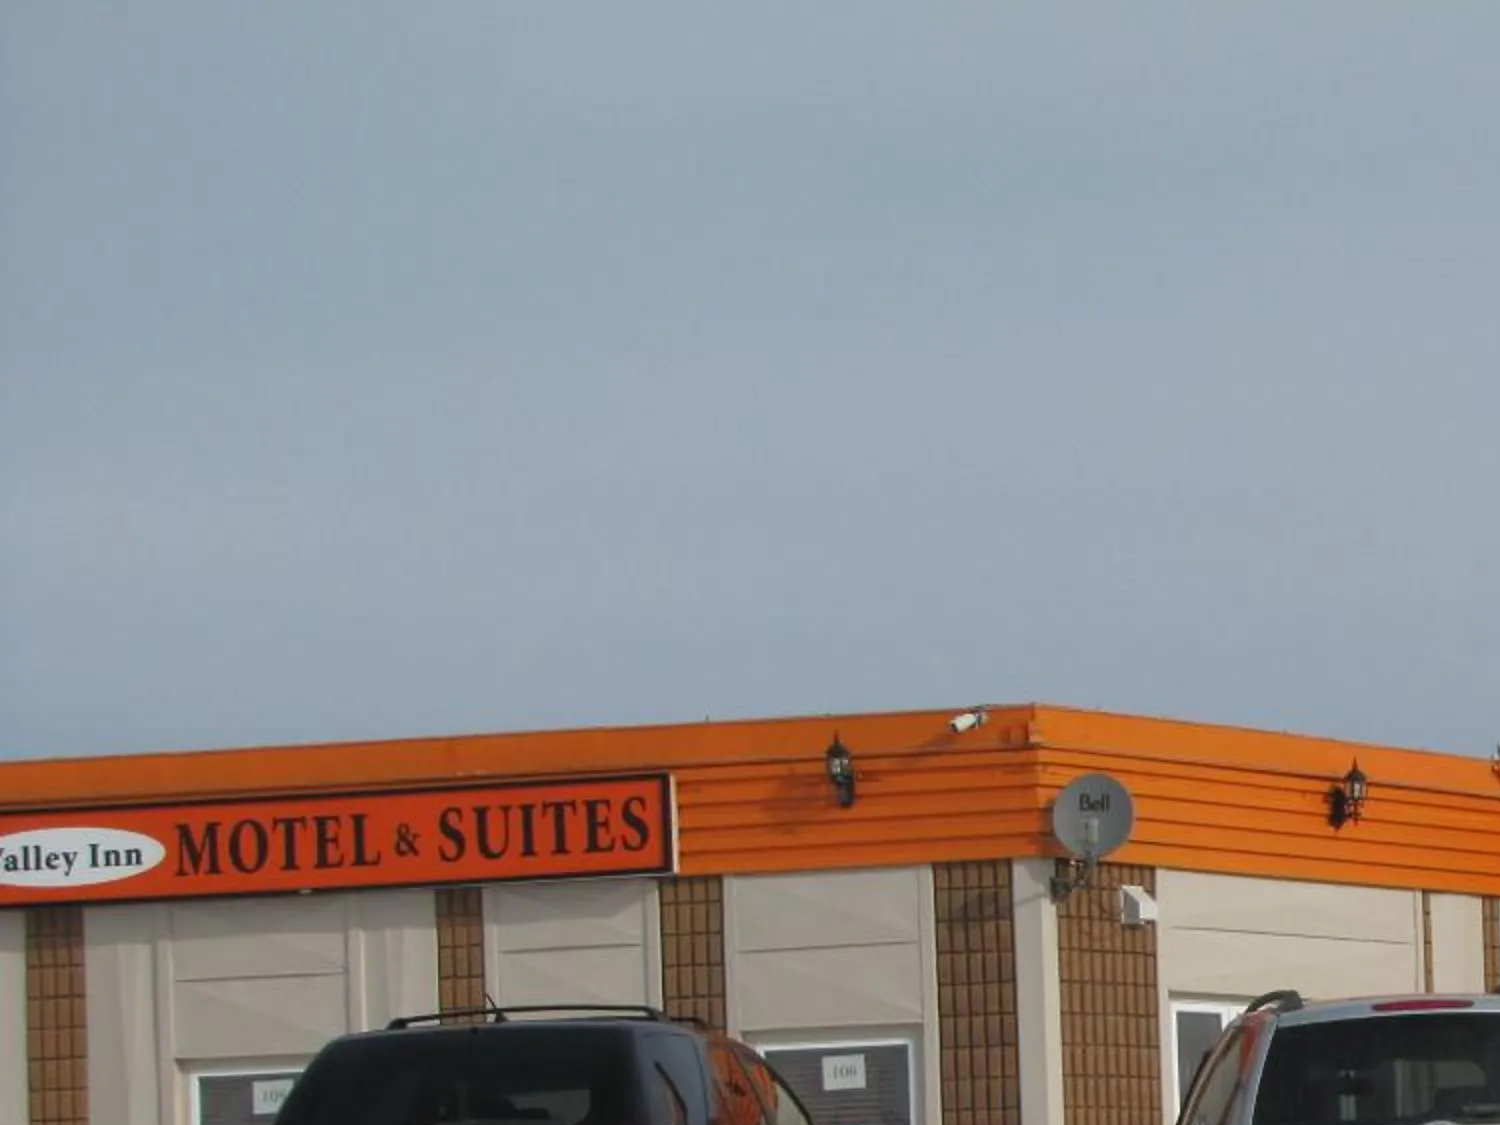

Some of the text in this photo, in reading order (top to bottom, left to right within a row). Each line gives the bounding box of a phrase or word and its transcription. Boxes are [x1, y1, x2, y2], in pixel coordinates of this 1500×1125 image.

[1078, 791, 1111, 814] Bell
[173, 795, 650, 877] MOTEL & SUITES
[0, 842, 143, 877] alley Inn
